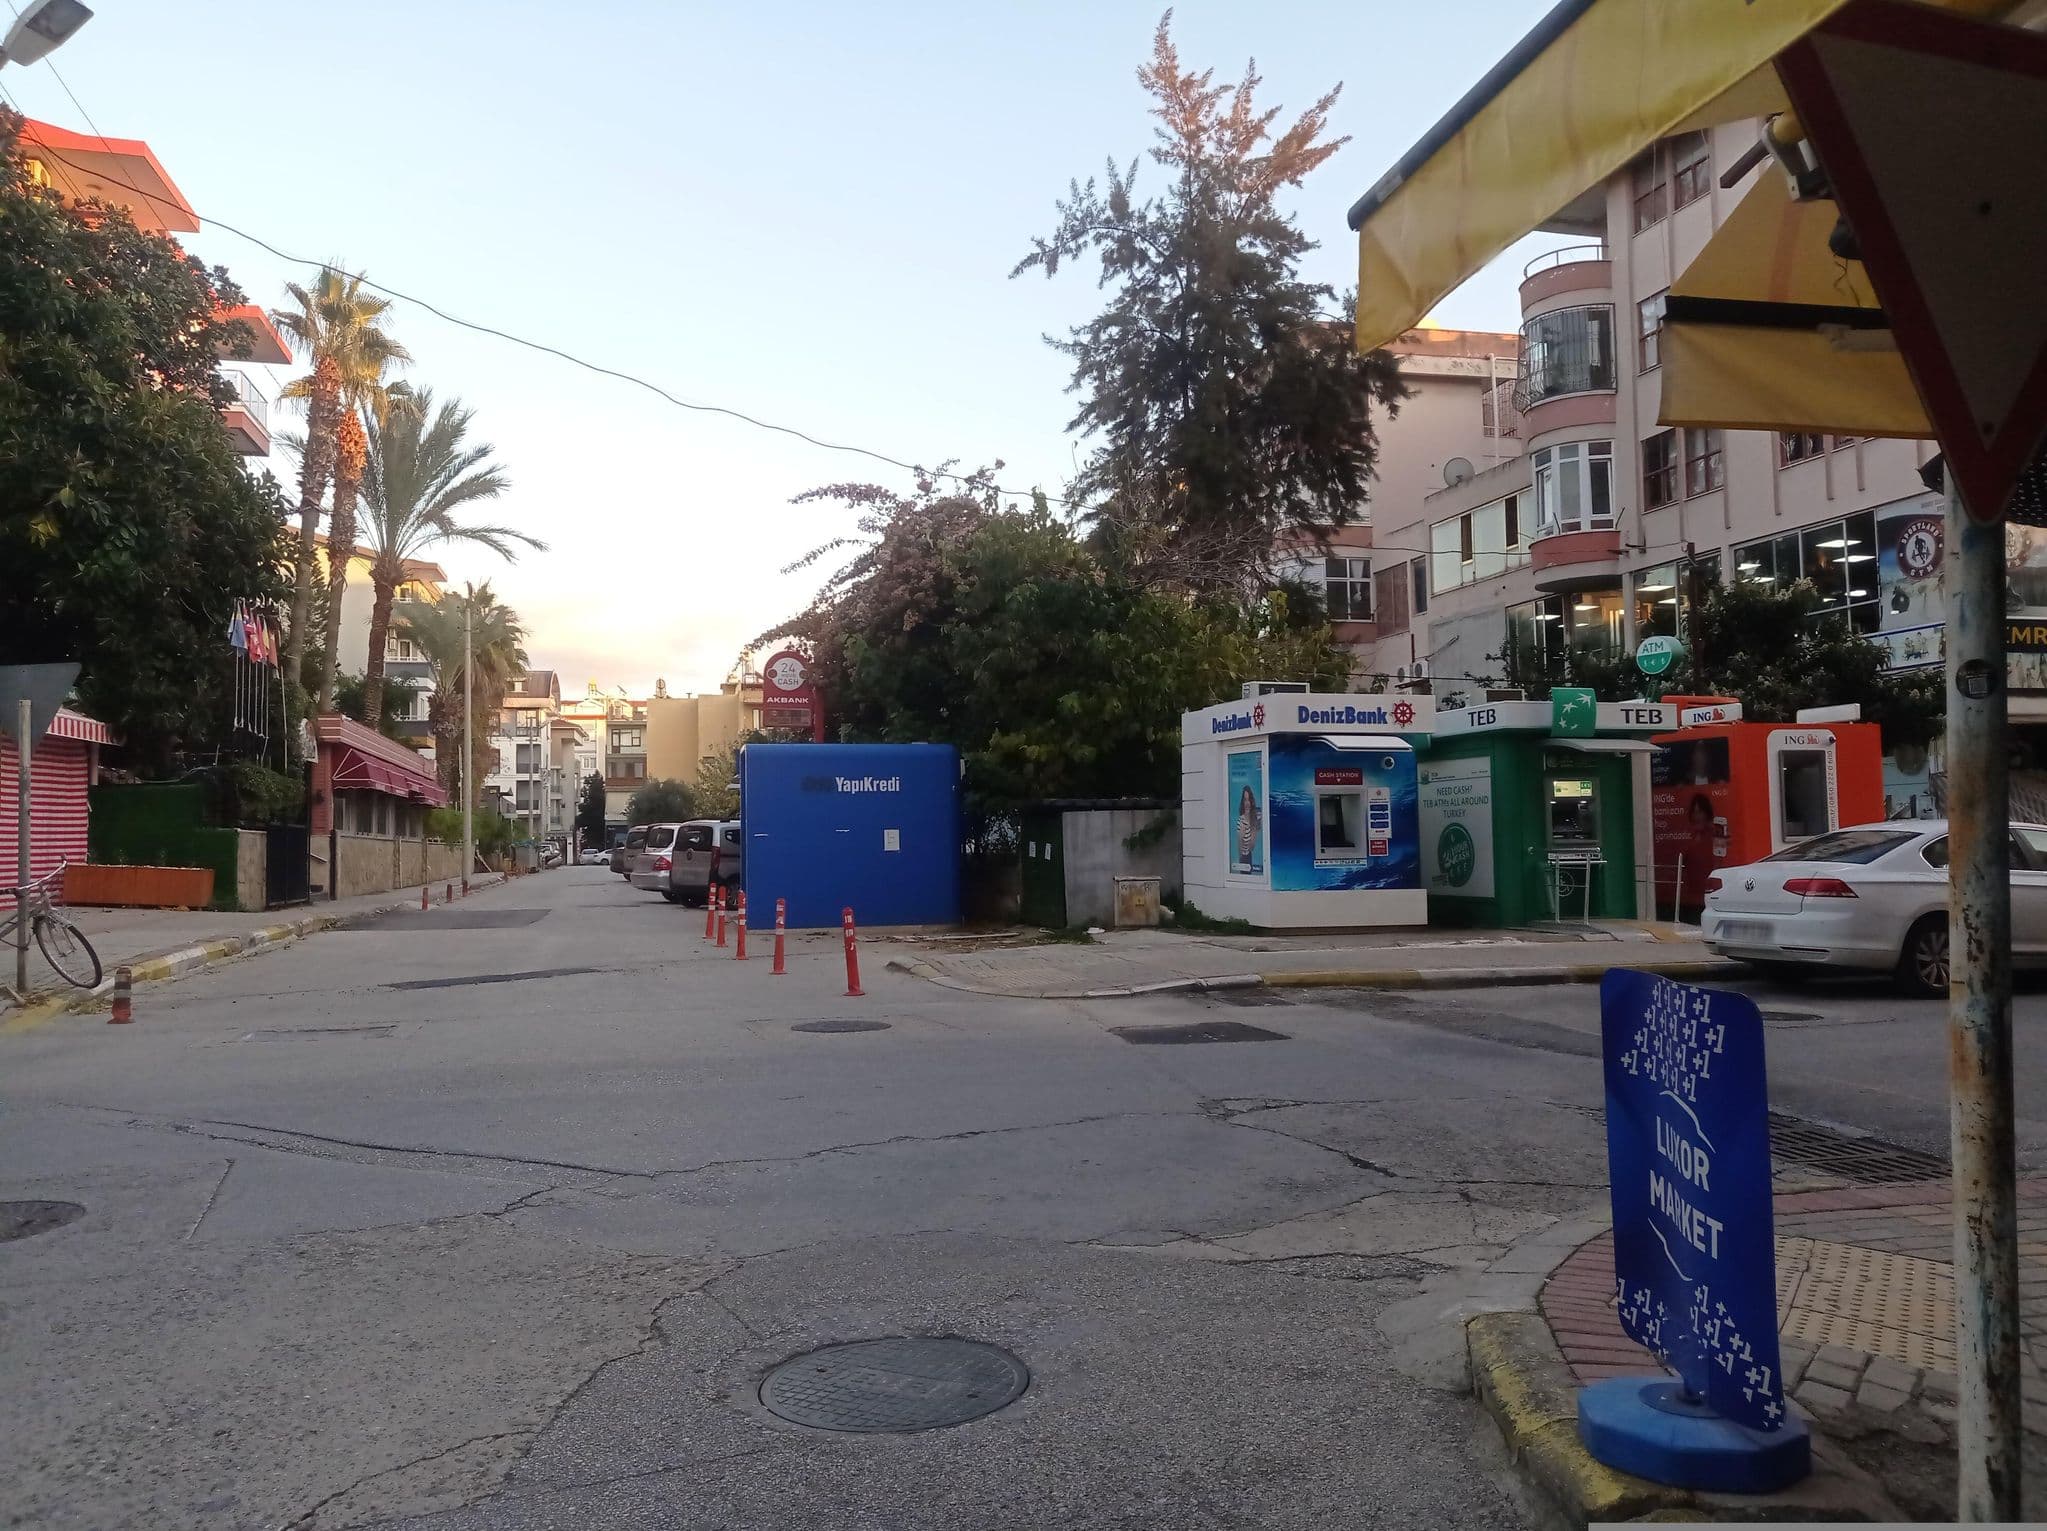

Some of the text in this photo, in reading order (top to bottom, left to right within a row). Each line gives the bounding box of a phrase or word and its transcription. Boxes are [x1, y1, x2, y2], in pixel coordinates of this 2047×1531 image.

[2006, 626, 2047, 645] MR
[1642, 641, 1664, 654] ATM
[781, 663, 797, 673] 24
[777, 678, 799, 686] CASH
[1212, 712, 1253, 735] DenizBank
[1297, 705, 1389, 726] DenizBank
[1468, 708, 1496, 727] TEB
[1620, 708, 1662, 725] TEB
[1692, 710, 1711, 722] ING
[1784, 735, 1805, 744] ING
[1437, 786, 1452, 797] NEED
[1656, 1115, 1710, 1192] LUXOR
[1650, 1169, 1723, 1260] MARKET
